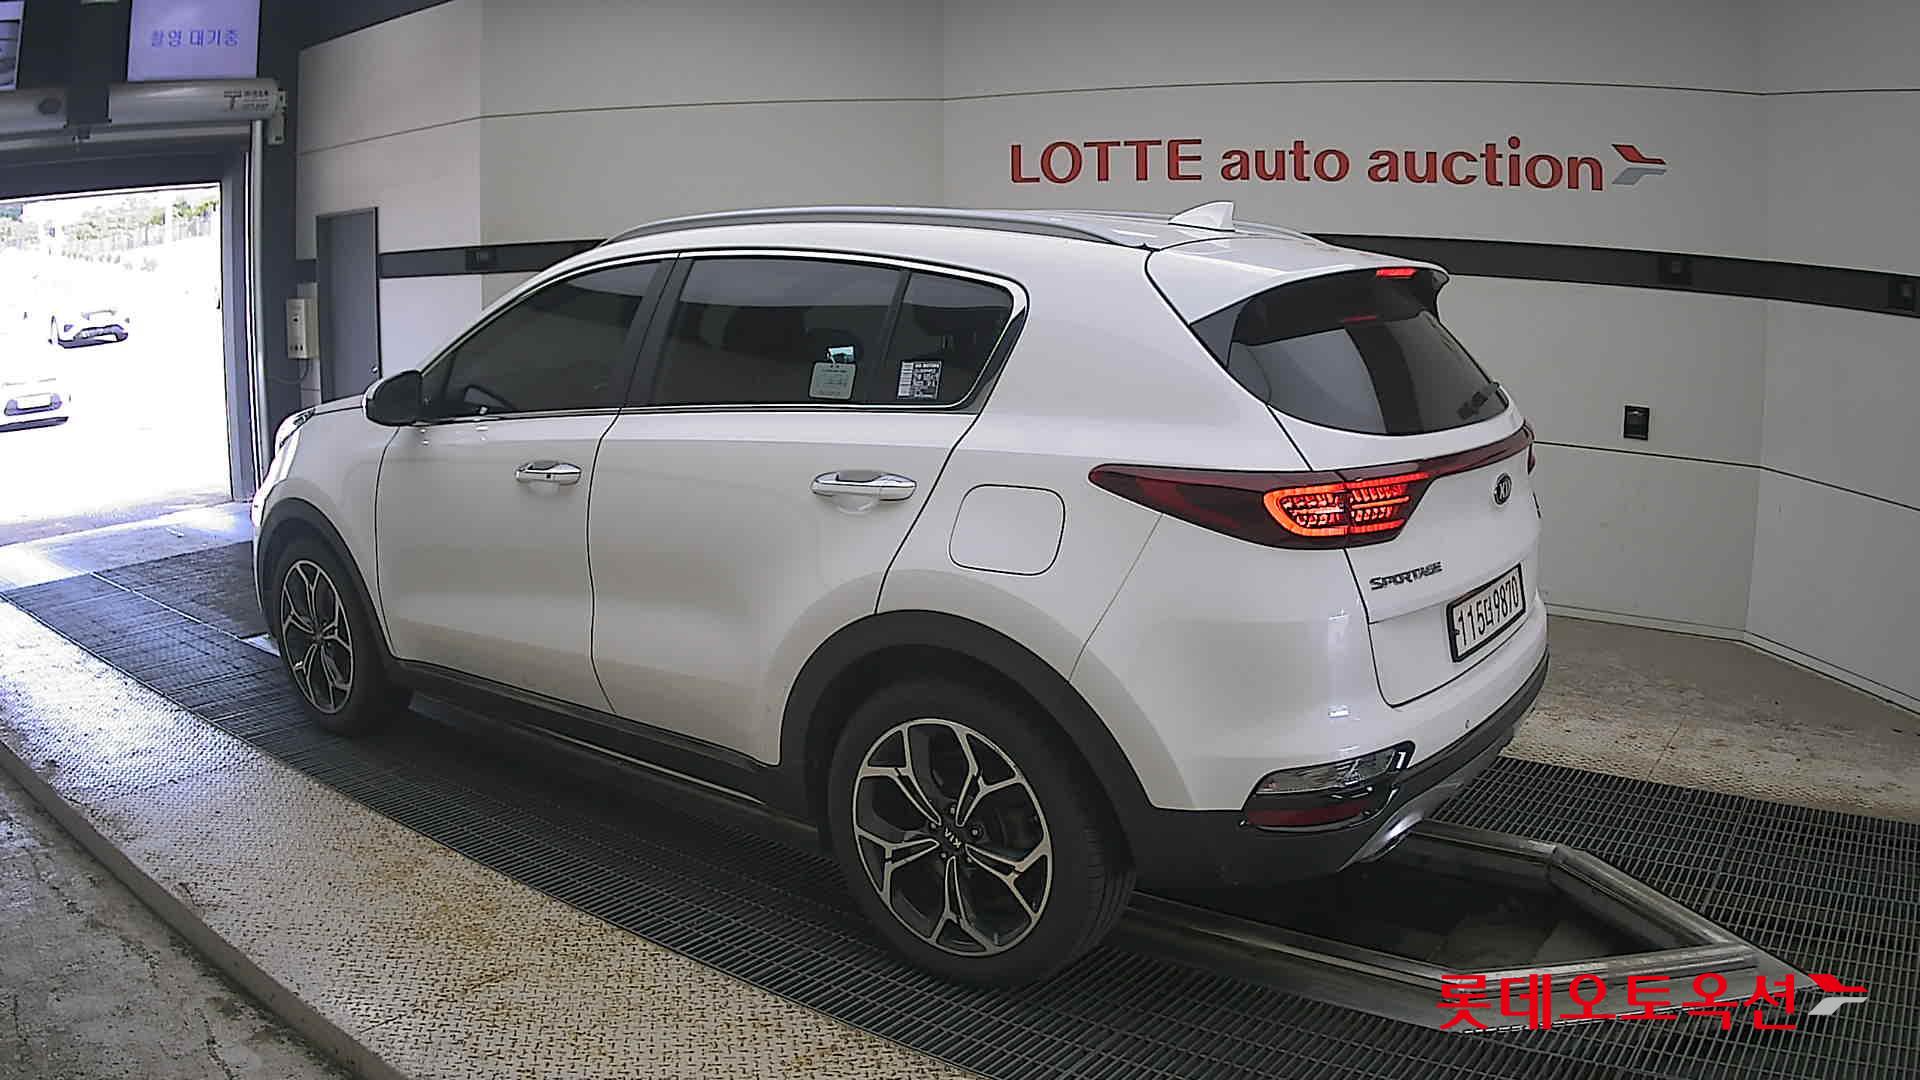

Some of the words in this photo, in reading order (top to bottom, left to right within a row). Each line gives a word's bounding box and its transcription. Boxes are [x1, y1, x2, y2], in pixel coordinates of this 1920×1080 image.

[1010, 139, 1202, 183] LOTTE
[1220, 140, 1350, 182] auto
[1367, 136, 1604, 191] auction
[1369, 561, 1443, 591] SPORTAGE
